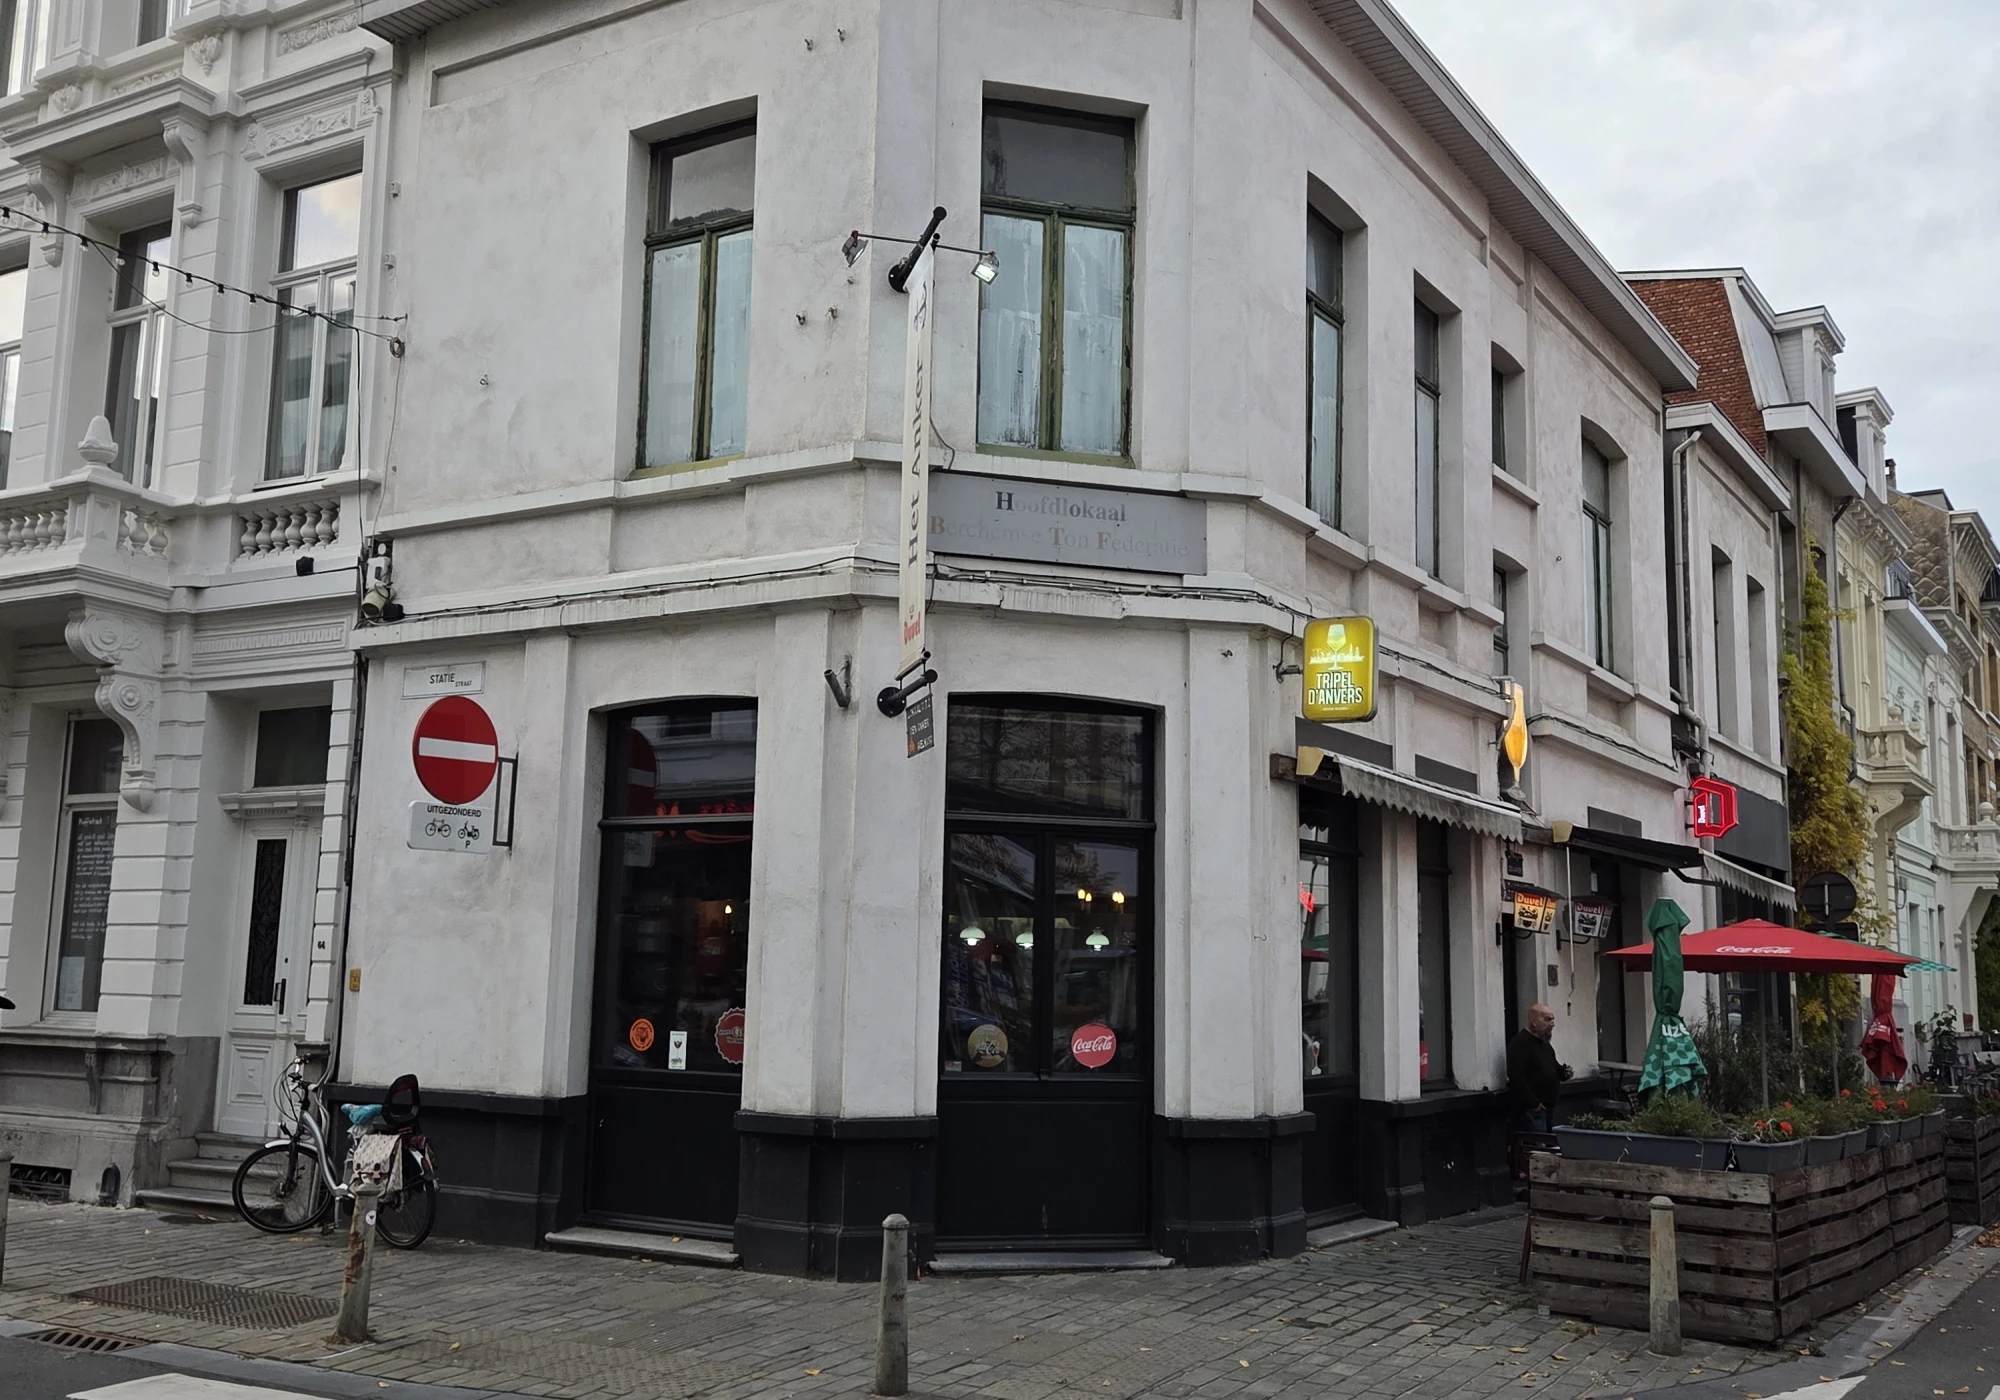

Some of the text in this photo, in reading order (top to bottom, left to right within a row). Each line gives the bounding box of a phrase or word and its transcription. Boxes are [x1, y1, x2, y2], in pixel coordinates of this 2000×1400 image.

[995, 490, 1127, 522] Hoofdlokaal
[908, 489, 920, 568] Het
[929, 514, 1190, 558] Berchemse Ton Federatie
[429, 672, 456, 685] STATIE
[455, 680, 473, 688] STRAAT
[1316, 672, 1354, 688] TRIPEL
[1308, 688, 1363, 705] D'ANVERS
[427, 804, 482, 818] UITGEZONDERD
[465, 840, 471, 849] P
[1517, 892, 1544, 907] Duvel
[1576, 902, 1602, 914] Duvel
[317, 940, 326, 950] 64
[1073, 1034, 1114, 1054] Coca-Cola
